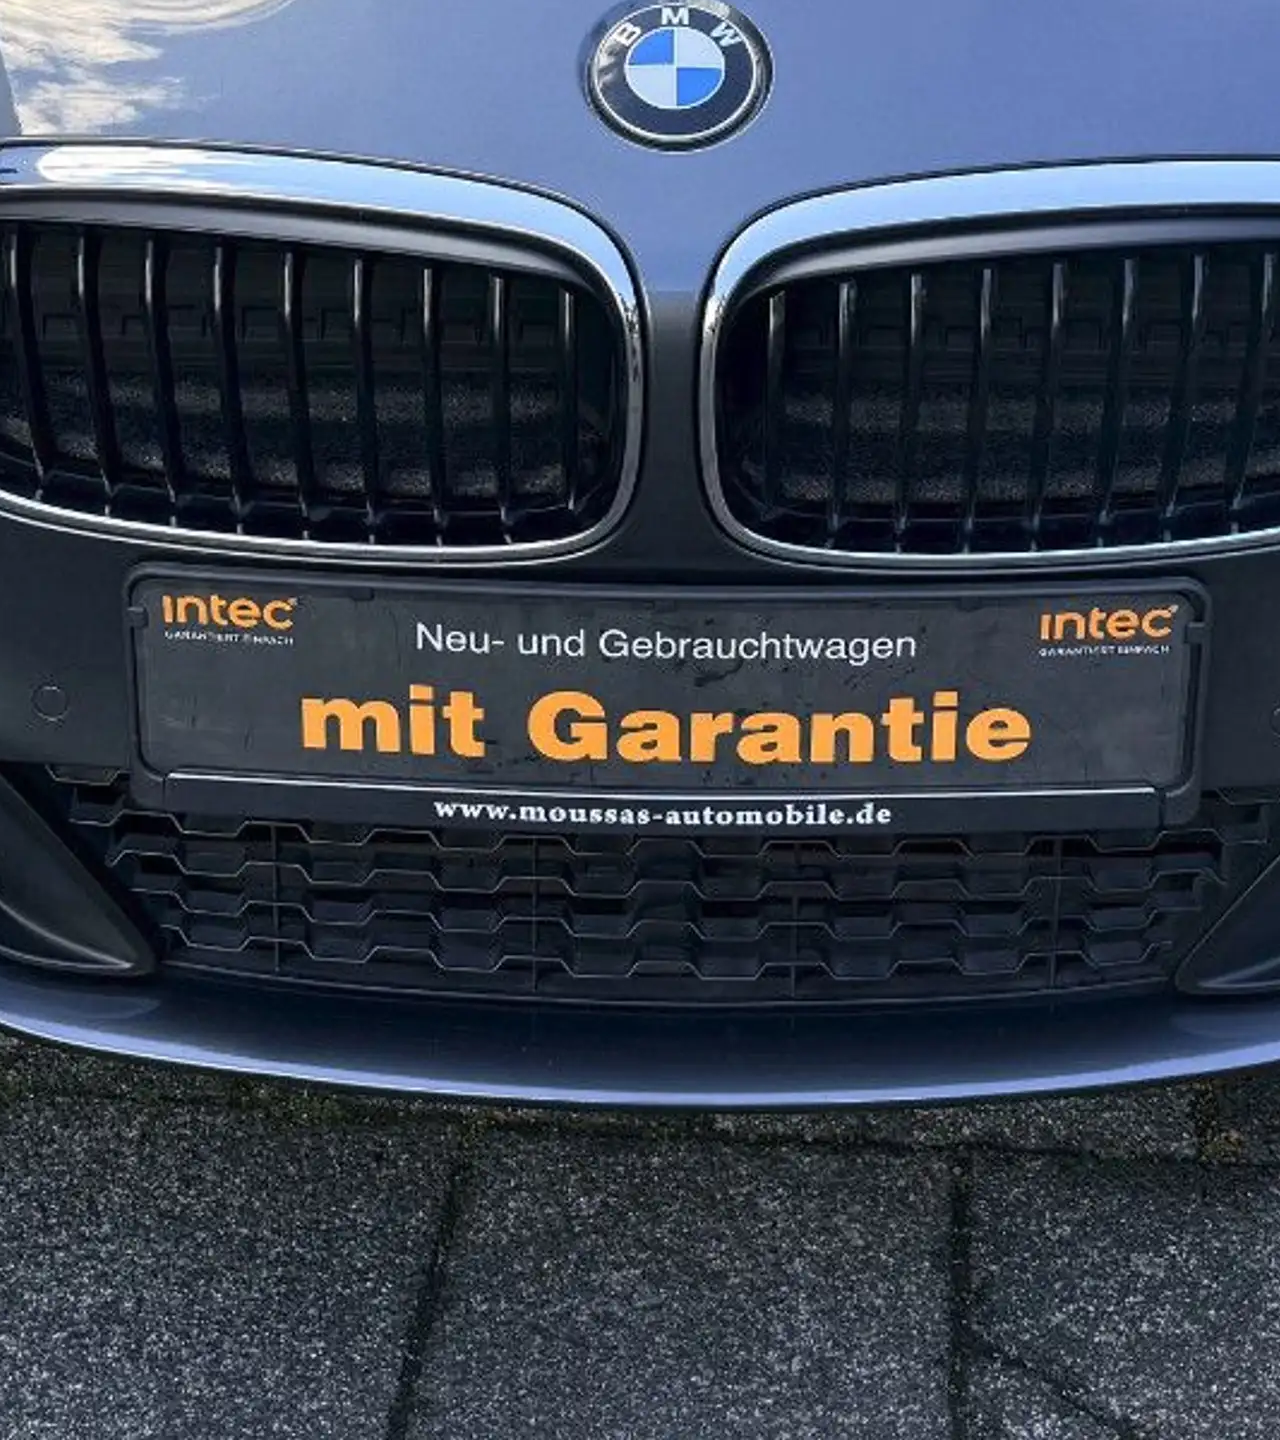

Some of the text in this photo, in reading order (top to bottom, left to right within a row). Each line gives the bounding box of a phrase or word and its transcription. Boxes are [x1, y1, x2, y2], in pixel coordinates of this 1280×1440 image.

[612, 7, 742, 48] BMW
[162, 593, 297, 631] intec
[1040, 606, 1176, 639] intec
[416, 623, 917, 666] Neu- und Gebrauchtwagen
[301, 683, 1032, 765] mit Garantie
[433, 799, 893, 827] www.moussas-automobile.de
